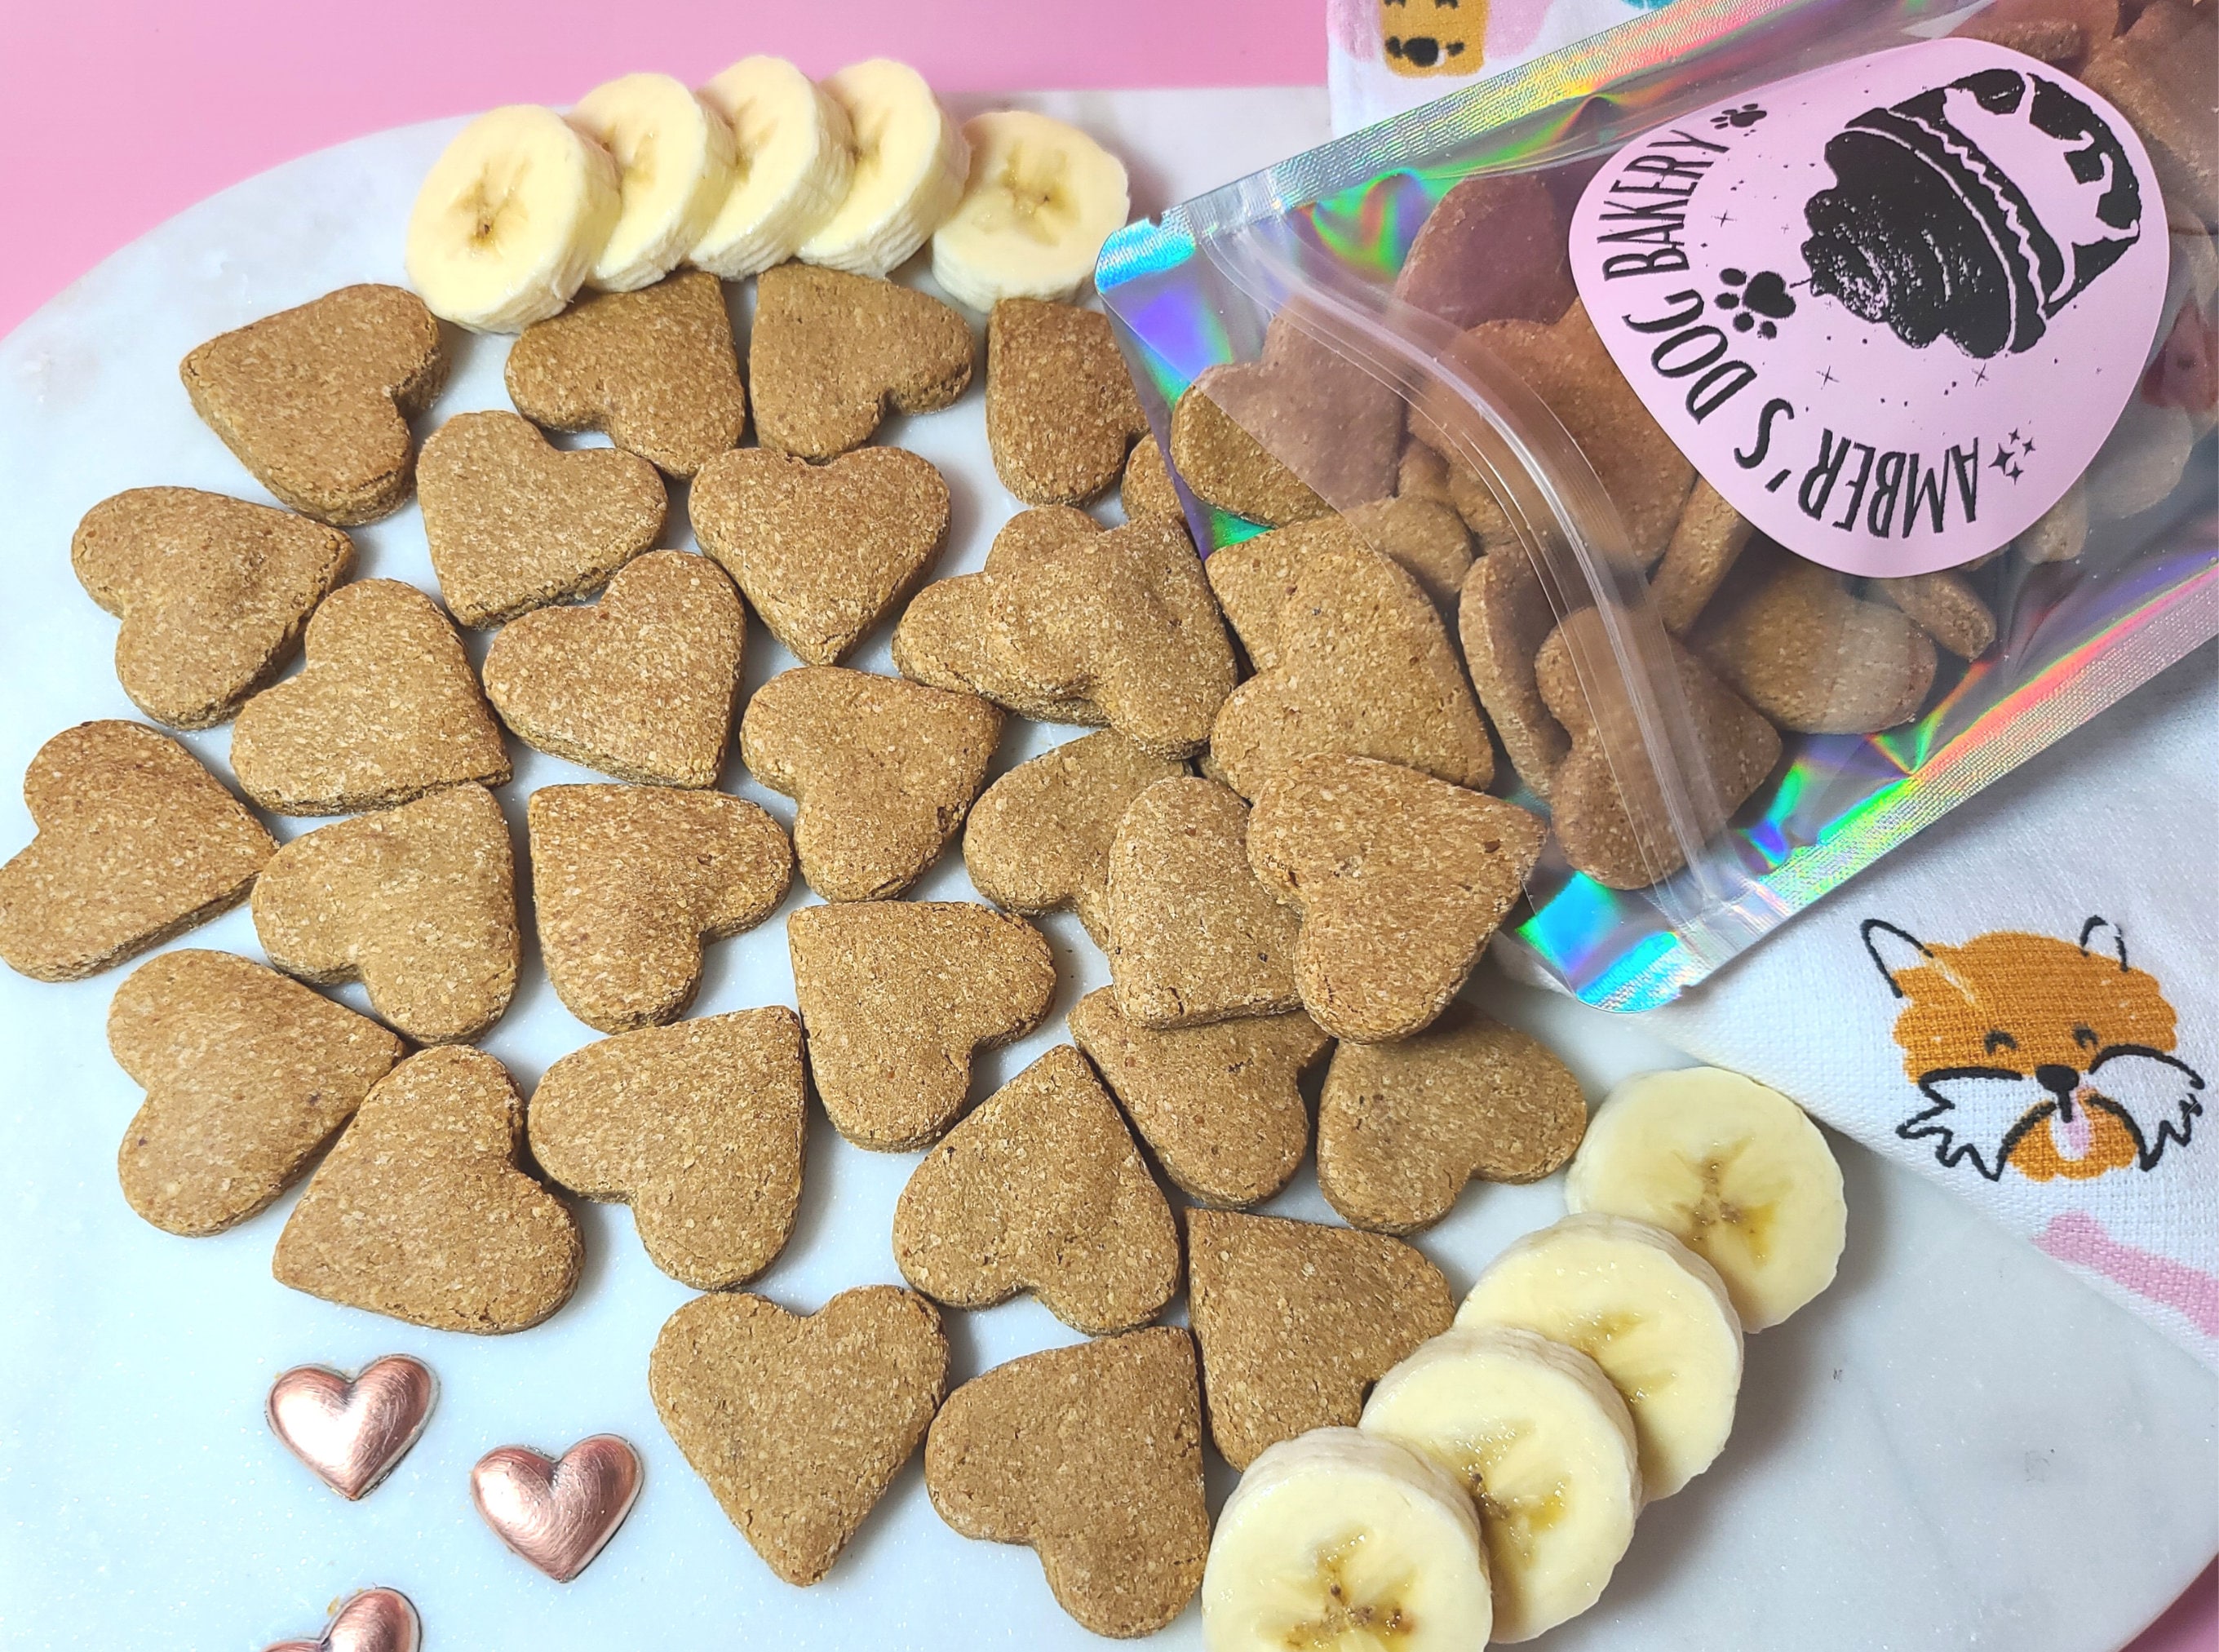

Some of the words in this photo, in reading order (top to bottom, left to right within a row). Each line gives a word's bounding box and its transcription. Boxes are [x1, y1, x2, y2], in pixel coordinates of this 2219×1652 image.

[1597, 129, 1730, 281] BAKERY
[1622, 288, 1758, 425] DOG
[1733, 397, 1980, 539] AMBER'S
